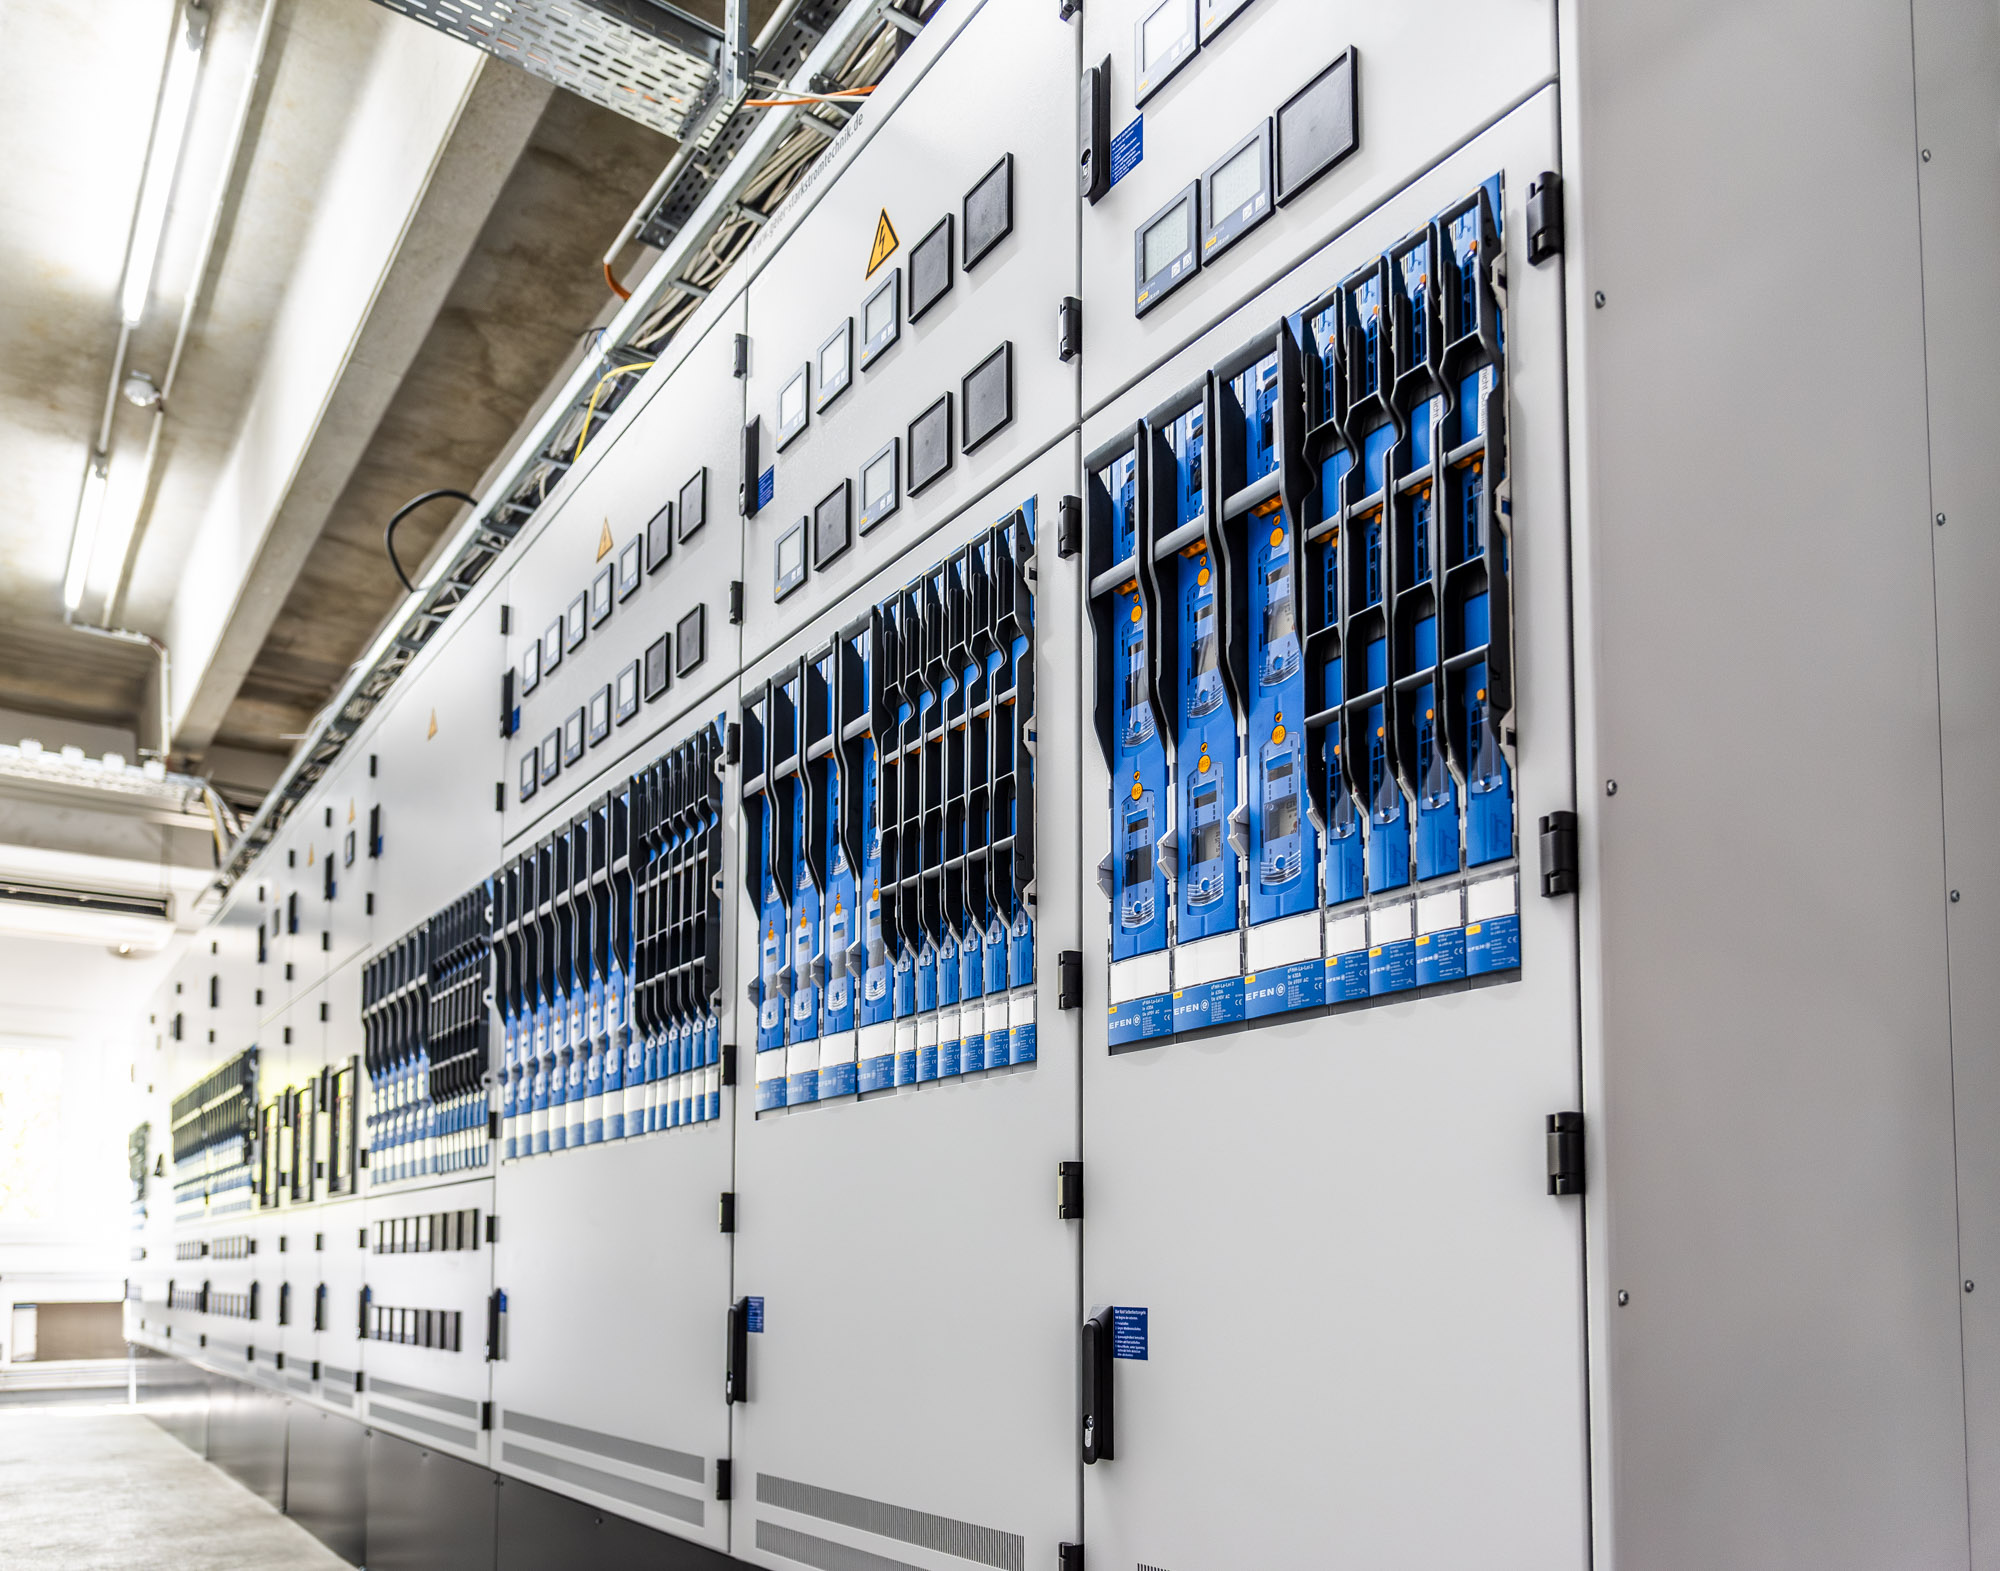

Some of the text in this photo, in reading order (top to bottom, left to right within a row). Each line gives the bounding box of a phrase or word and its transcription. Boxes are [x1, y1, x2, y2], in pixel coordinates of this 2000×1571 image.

[1246, 987, 1274, 1001] EFEN
[1174, 1003, 1199, 1015] EFEN
[1109, 1018, 1131, 1030] EFEN
